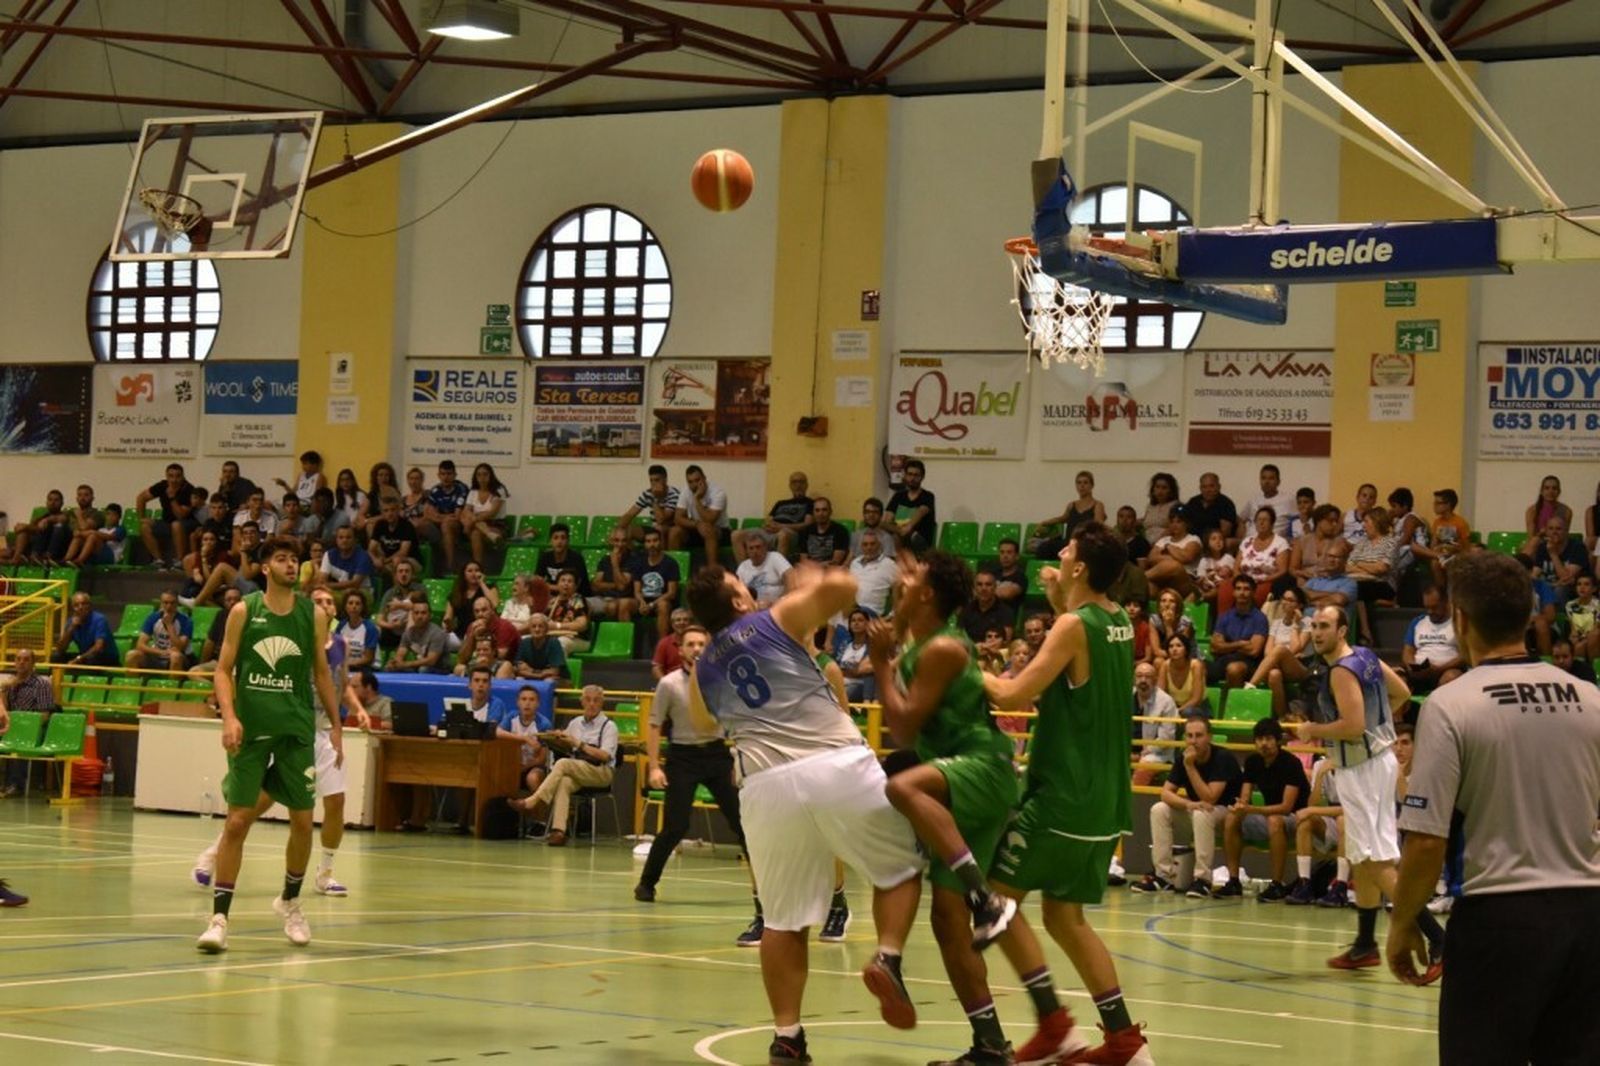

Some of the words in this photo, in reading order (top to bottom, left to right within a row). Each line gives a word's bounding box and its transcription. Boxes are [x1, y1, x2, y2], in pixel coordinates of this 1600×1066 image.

[1269, 237, 1393, 269] schelde
[1204, 360, 1241, 377] LA
[1249, 352, 1331, 378] NAVA
[1523, 348, 1600, 365] INSTALACI
[444, 370, 517, 389] REALE
[206, 382, 246, 397] WOOL
[270, 382, 298, 397] TIME
[443, 390, 517, 404] SEGUROS
[539, 388, 571, 404] Sta
[576, 387, 640, 404] Teresa
[896, 370, 1021, 440] aQuabel
[1245, 406, 1264, 421] 619
[1266, 407, 1278, 419] 25
[1279, 408, 1293, 421] 33
[1294, 408, 1309, 421] 43
[1492, 412, 1532, 430] 653
[1538, 413, 1576, 431] 991
[1584, 413, 1600, 431] 8
[247, 672, 294, 691] Unicaja
[727, 655, 771, 710] 8
